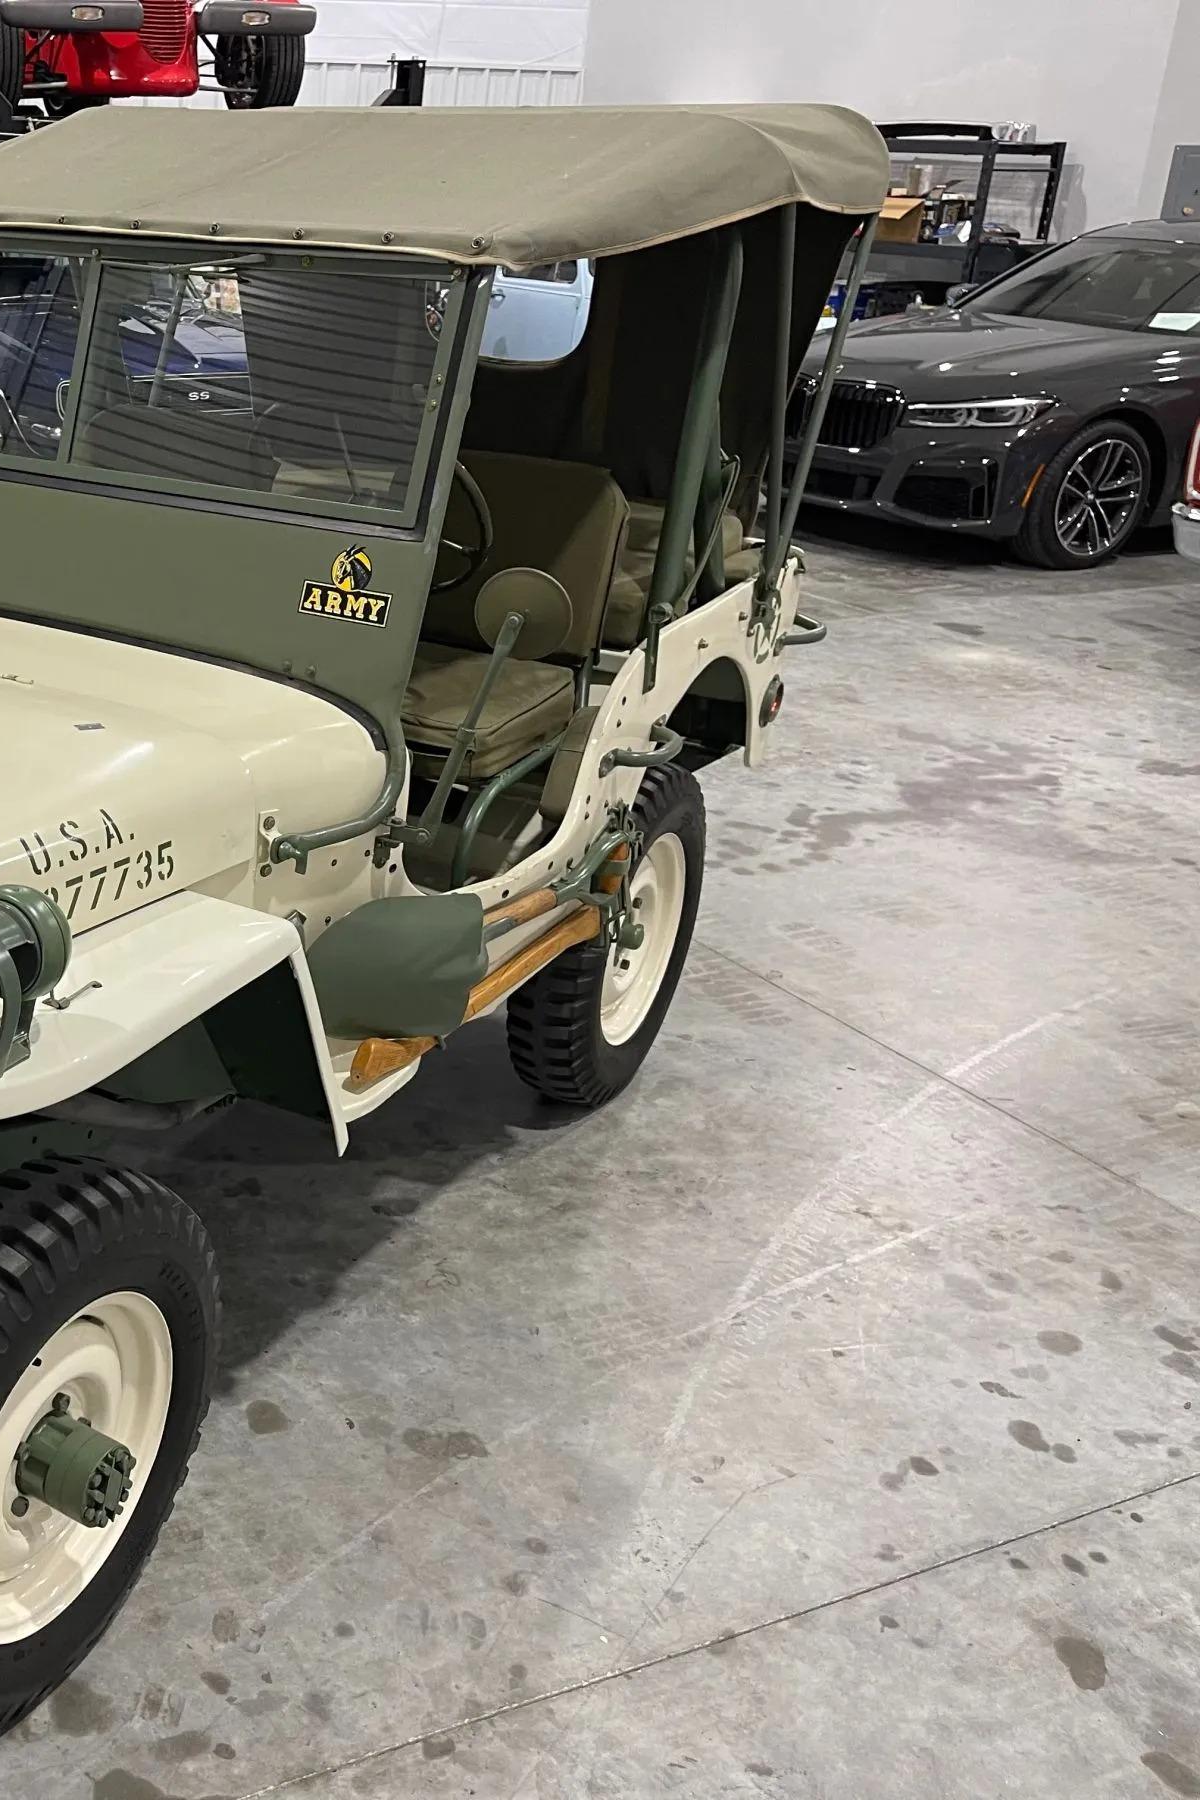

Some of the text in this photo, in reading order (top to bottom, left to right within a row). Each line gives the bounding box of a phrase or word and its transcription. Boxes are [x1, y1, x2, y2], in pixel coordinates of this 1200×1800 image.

[188, 391, 210, 401] SS
[303, 588, 385, 621] ARMY
[19, 808, 135, 876] U.S.A.
